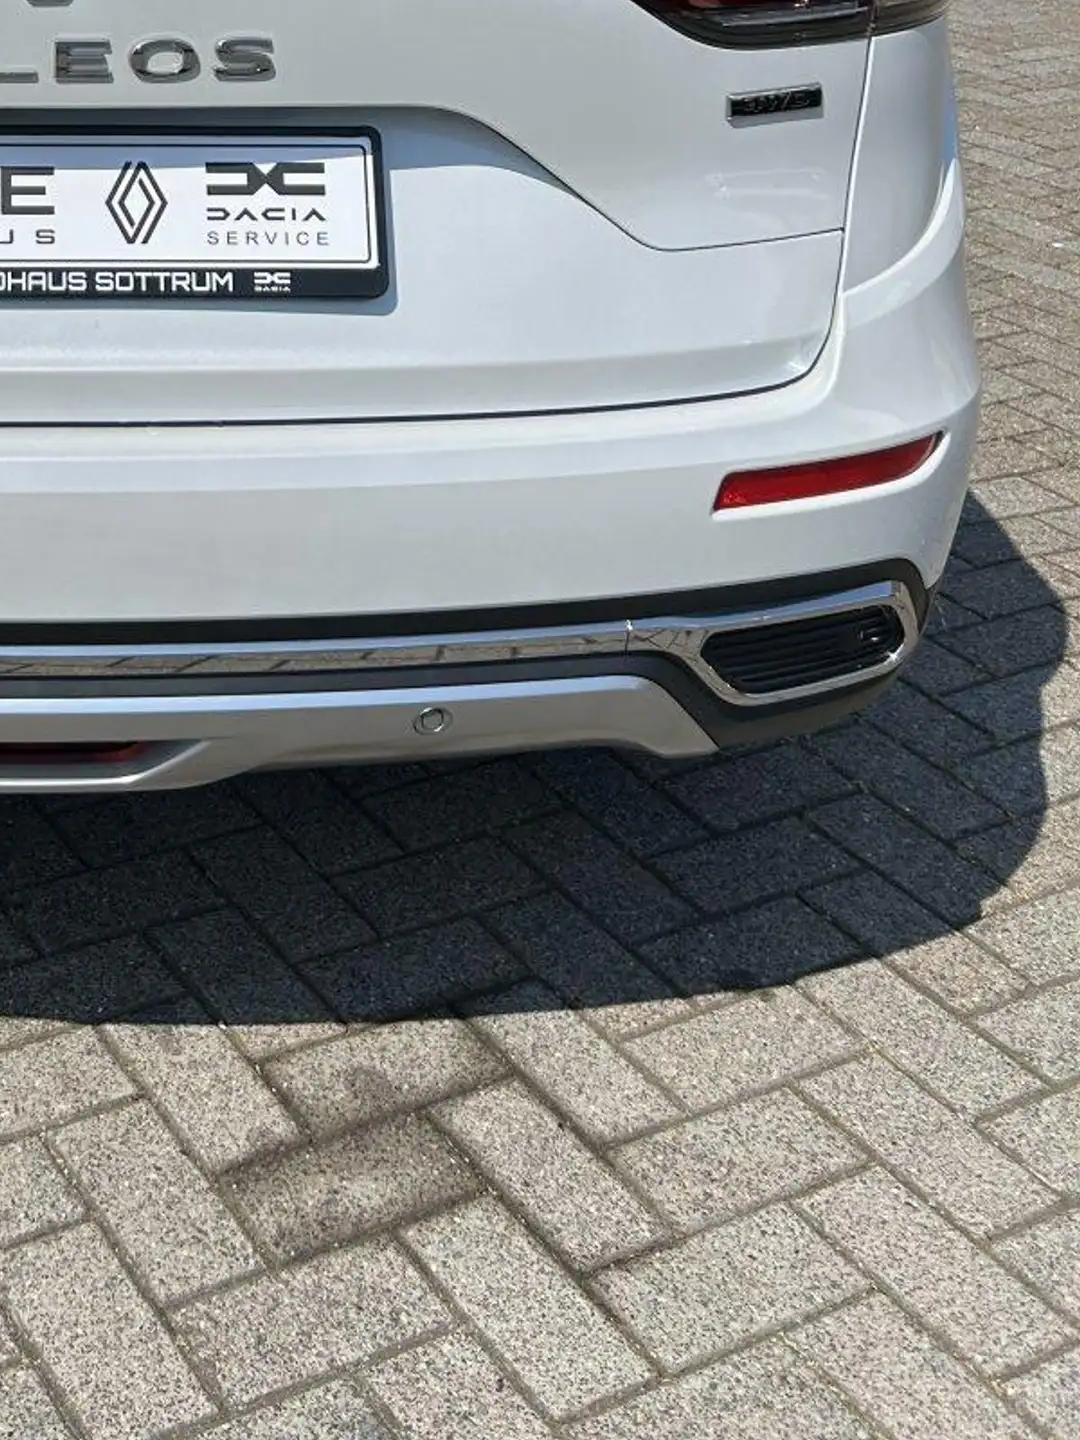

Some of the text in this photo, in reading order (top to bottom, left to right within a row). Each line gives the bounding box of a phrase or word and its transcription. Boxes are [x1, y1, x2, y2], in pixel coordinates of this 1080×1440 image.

[207, 208, 326, 222] DACIA
[207, 232, 330, 246] SERVICE
[94, 272, 234, 292] SOTTRUM
